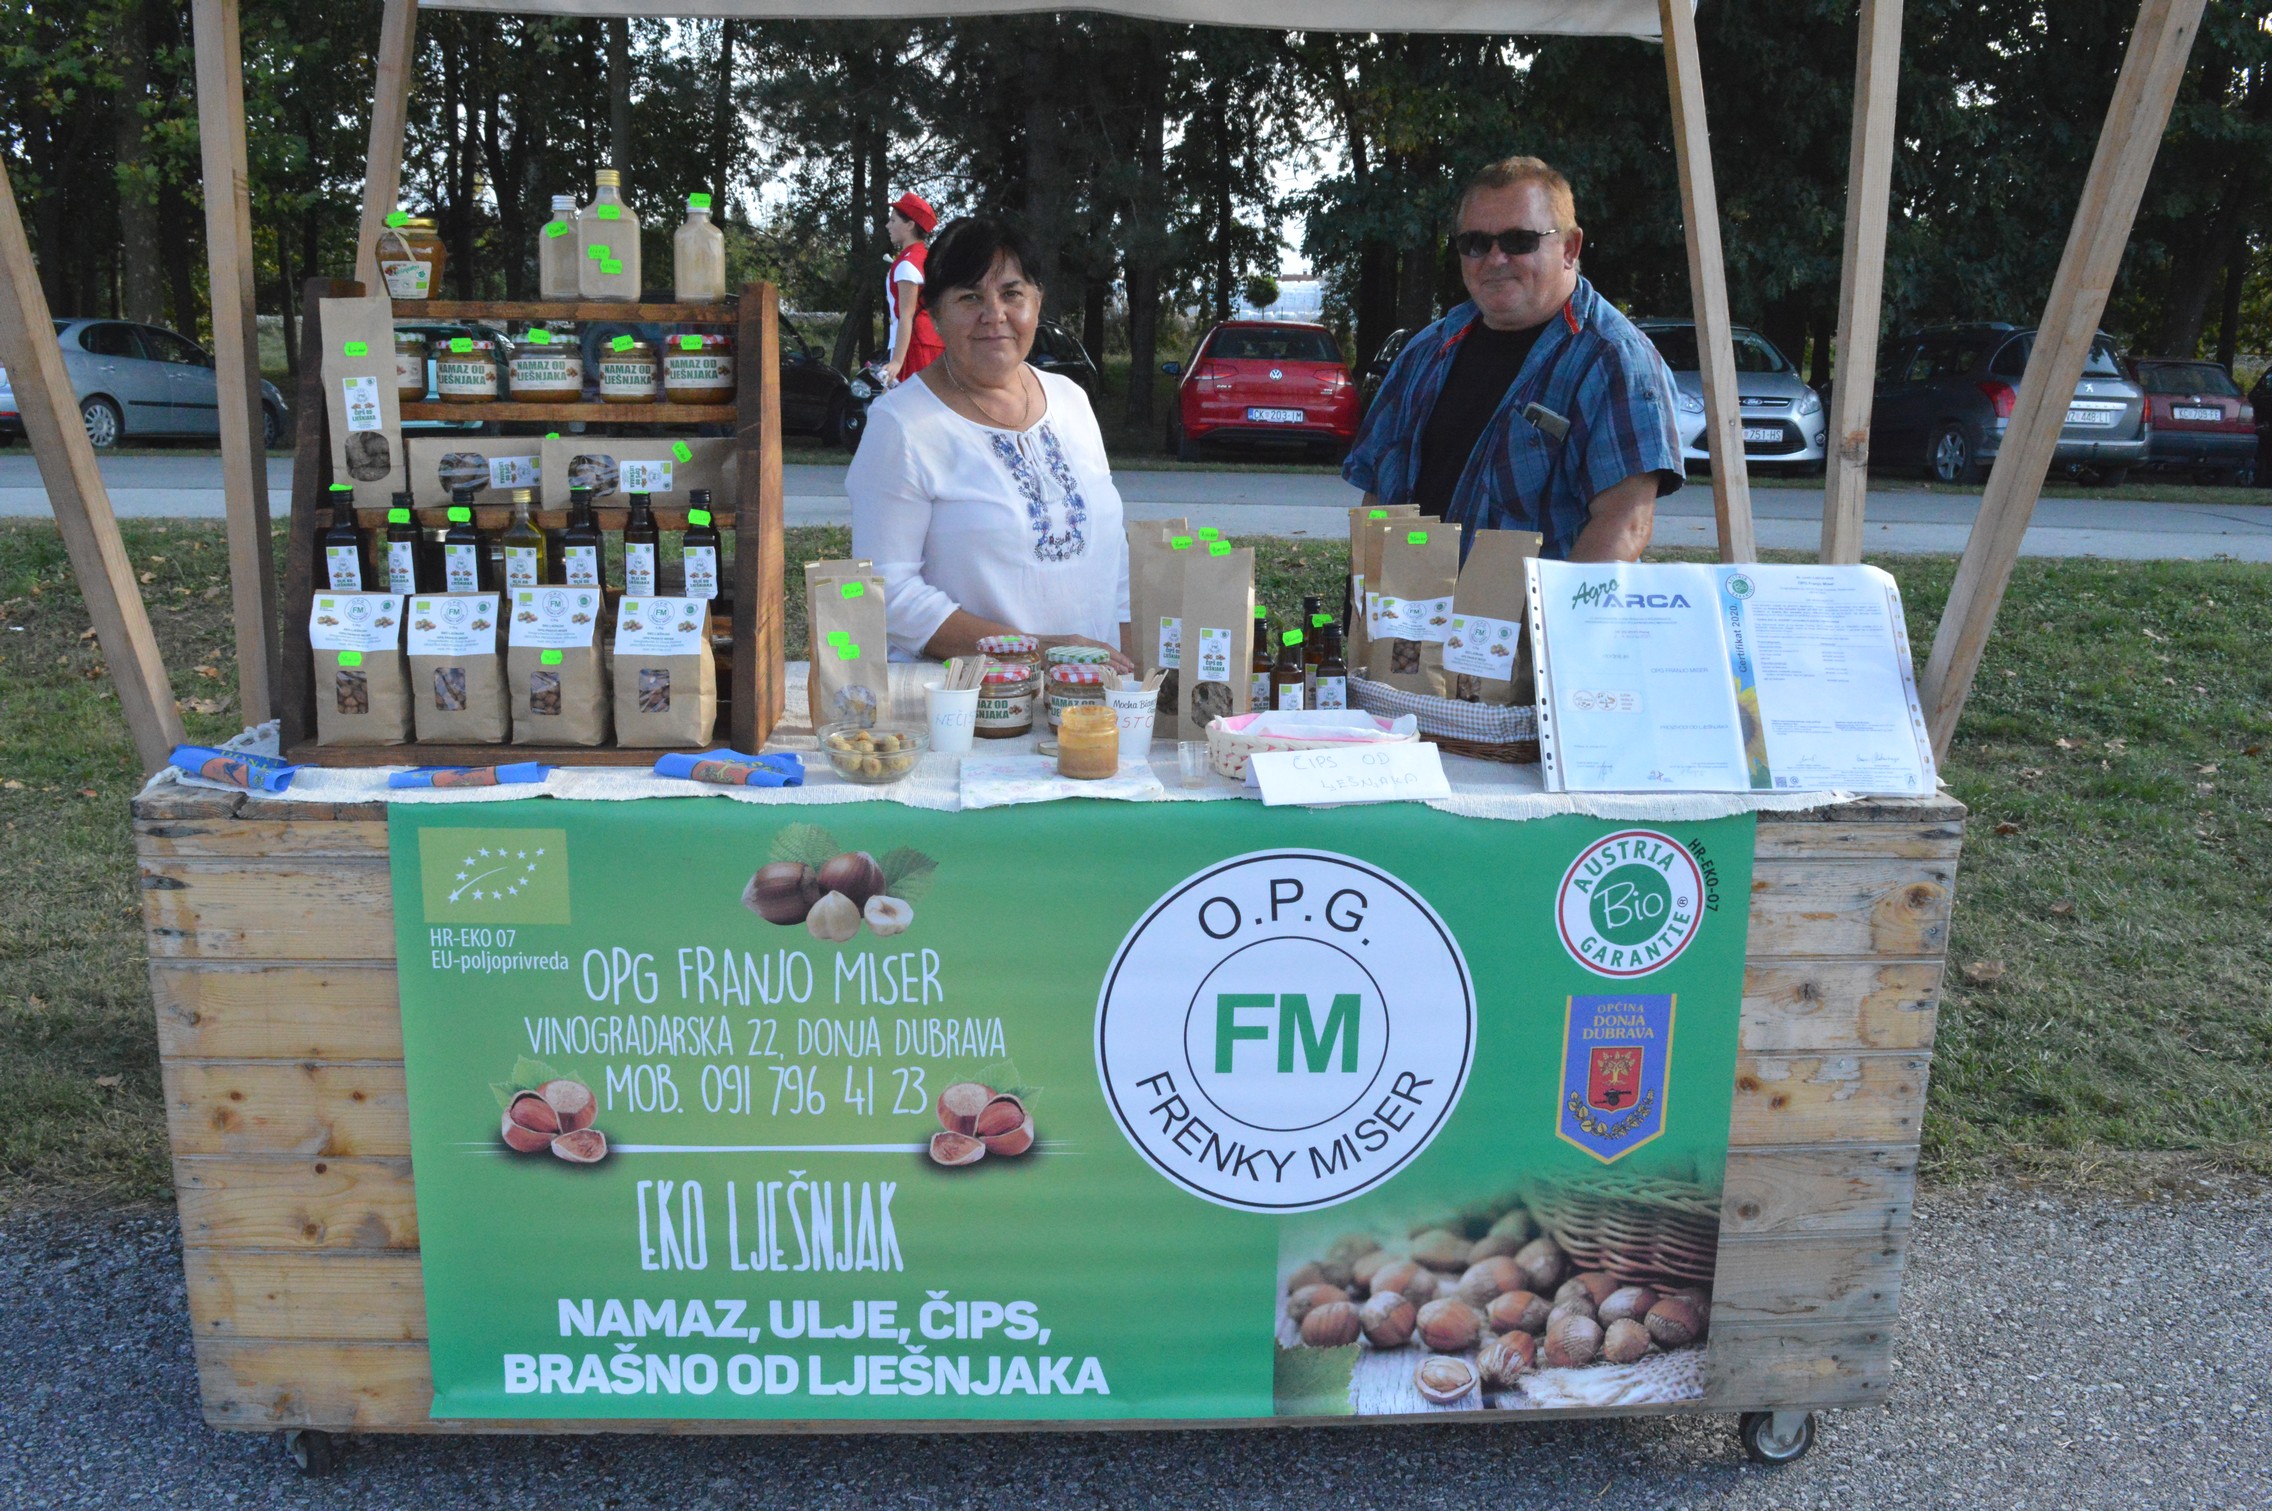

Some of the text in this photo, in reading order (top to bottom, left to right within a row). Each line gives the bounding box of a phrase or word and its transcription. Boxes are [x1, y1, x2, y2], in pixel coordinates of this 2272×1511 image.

[439, 363, 485, 374] NAMAZ OD
[517, 360, 566, 371] NAMAZ OD
[604, 364, 651, 375] NAMAZ OD
[670, 359, 717, 369] NAMAZ OD
[1571, 578, 1621, 611] Agro
[1601, 593, 1692, 609] ARCA
[1729, 602, 1749, 674] Certifikat 2020.
[994, 700, 1009, 709] OD
[1362, 751, 1390, 766] OD
[1573, 839, 1676, 895] AUSTRIA
[1687, 837, 1720, 913] HR-EKO-07
[1197, 877, 1372, 947] O.P.G.
[1593, 881, 1664, 929] Bio
[430, 928, 516, 948] HR-EKO 07
[1579, 911, 1692, 968] GARANTIE
[431, 949, 570, 975] EU-poljoprivreda
[582, 945, 944, 1007] OPG FRANJO MISER
[524, 1015, 1007, 1061] VINOGRADARSKA 22, DONJA DUBRAVA
[1213, 992, 1363, 1075] FM
[1582, 1026, 1655, 1040] DUBRAVA
[1593, 1015, 1646, 1027] DONJA
[605, 1063, 929, 1118] MOB. 091 796 41 23
[1135, 1070, 1435, 1184] FRENKY MISER
[636, 1168, 905, 1273] EKO LJEŠNJAK
[557, 1288, 1053, 1346] NAMAZ, ULJE, ČIPS,
[502, 1342, 1112, 1397] BRAŠNO OD LJEŠNJAKA
